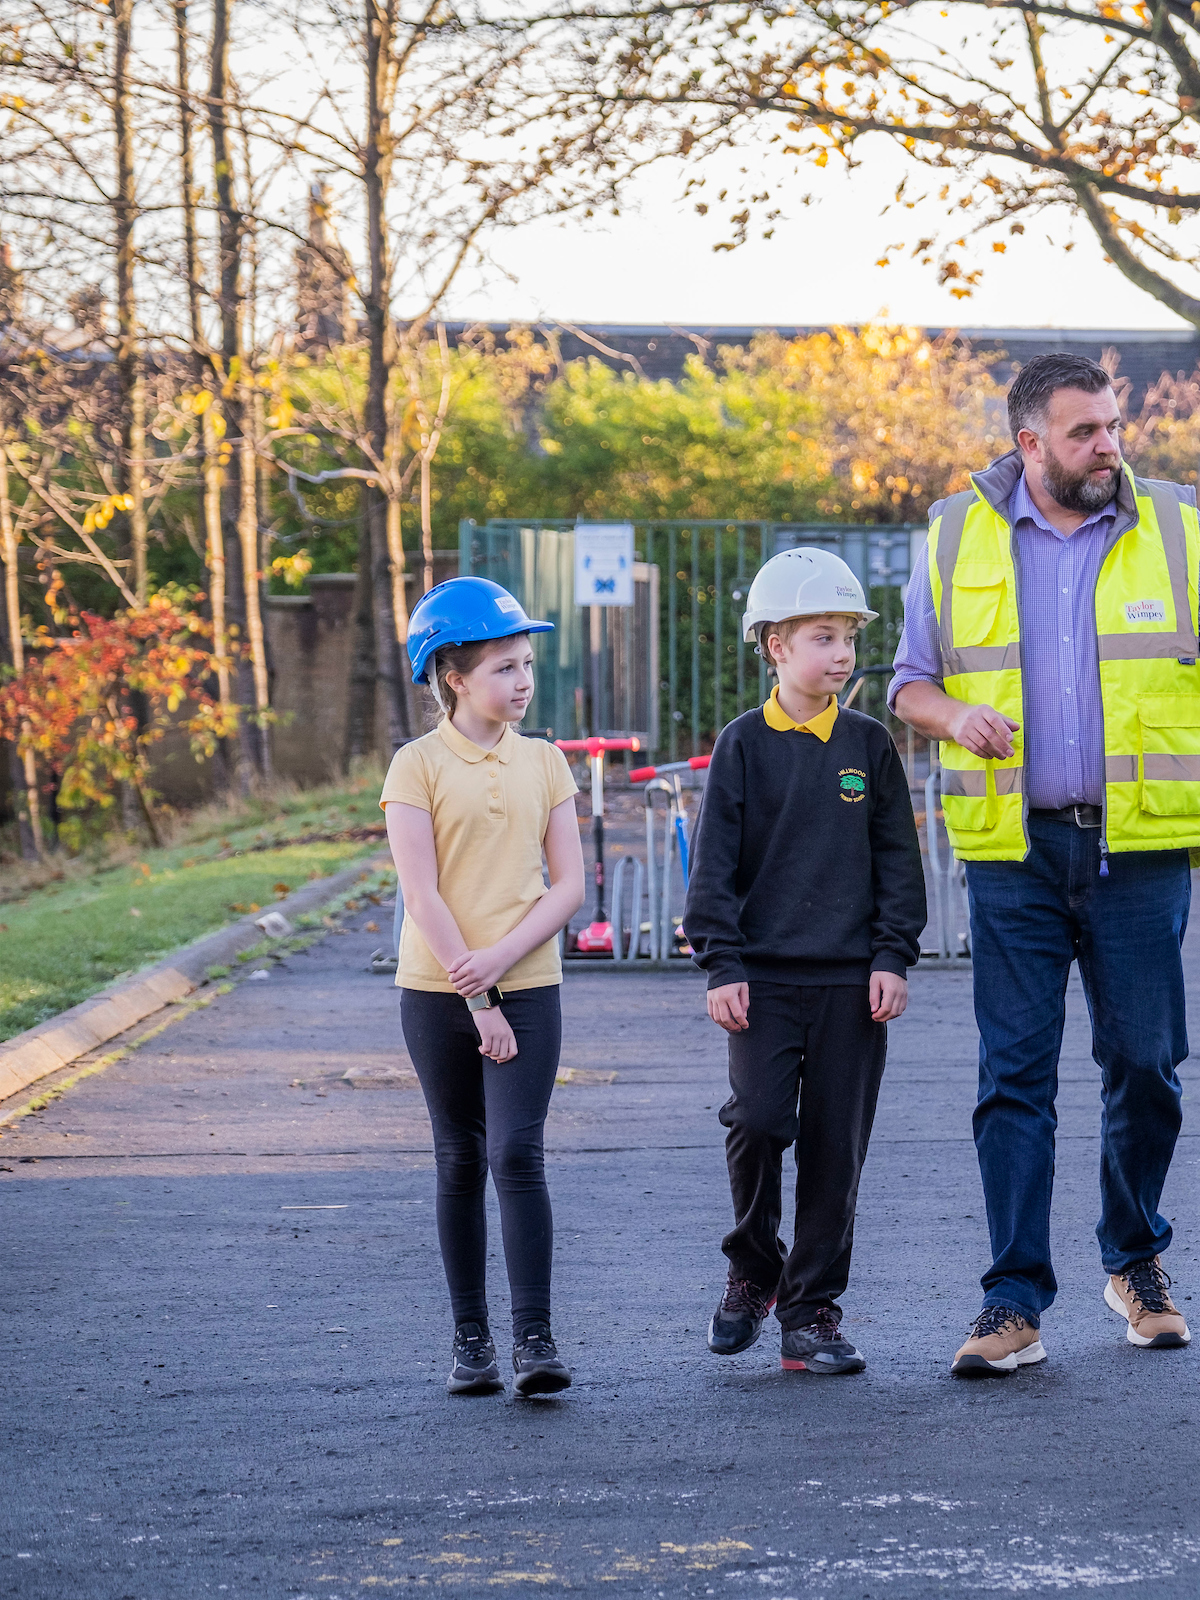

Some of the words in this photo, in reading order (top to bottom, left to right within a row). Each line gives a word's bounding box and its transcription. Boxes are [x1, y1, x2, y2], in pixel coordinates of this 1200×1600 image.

[1126, 601, 1154, 612] Taylor
[1127, 611, 1164, 620] Wimpey
[837, 768, 867, 777] HILLWOOD
